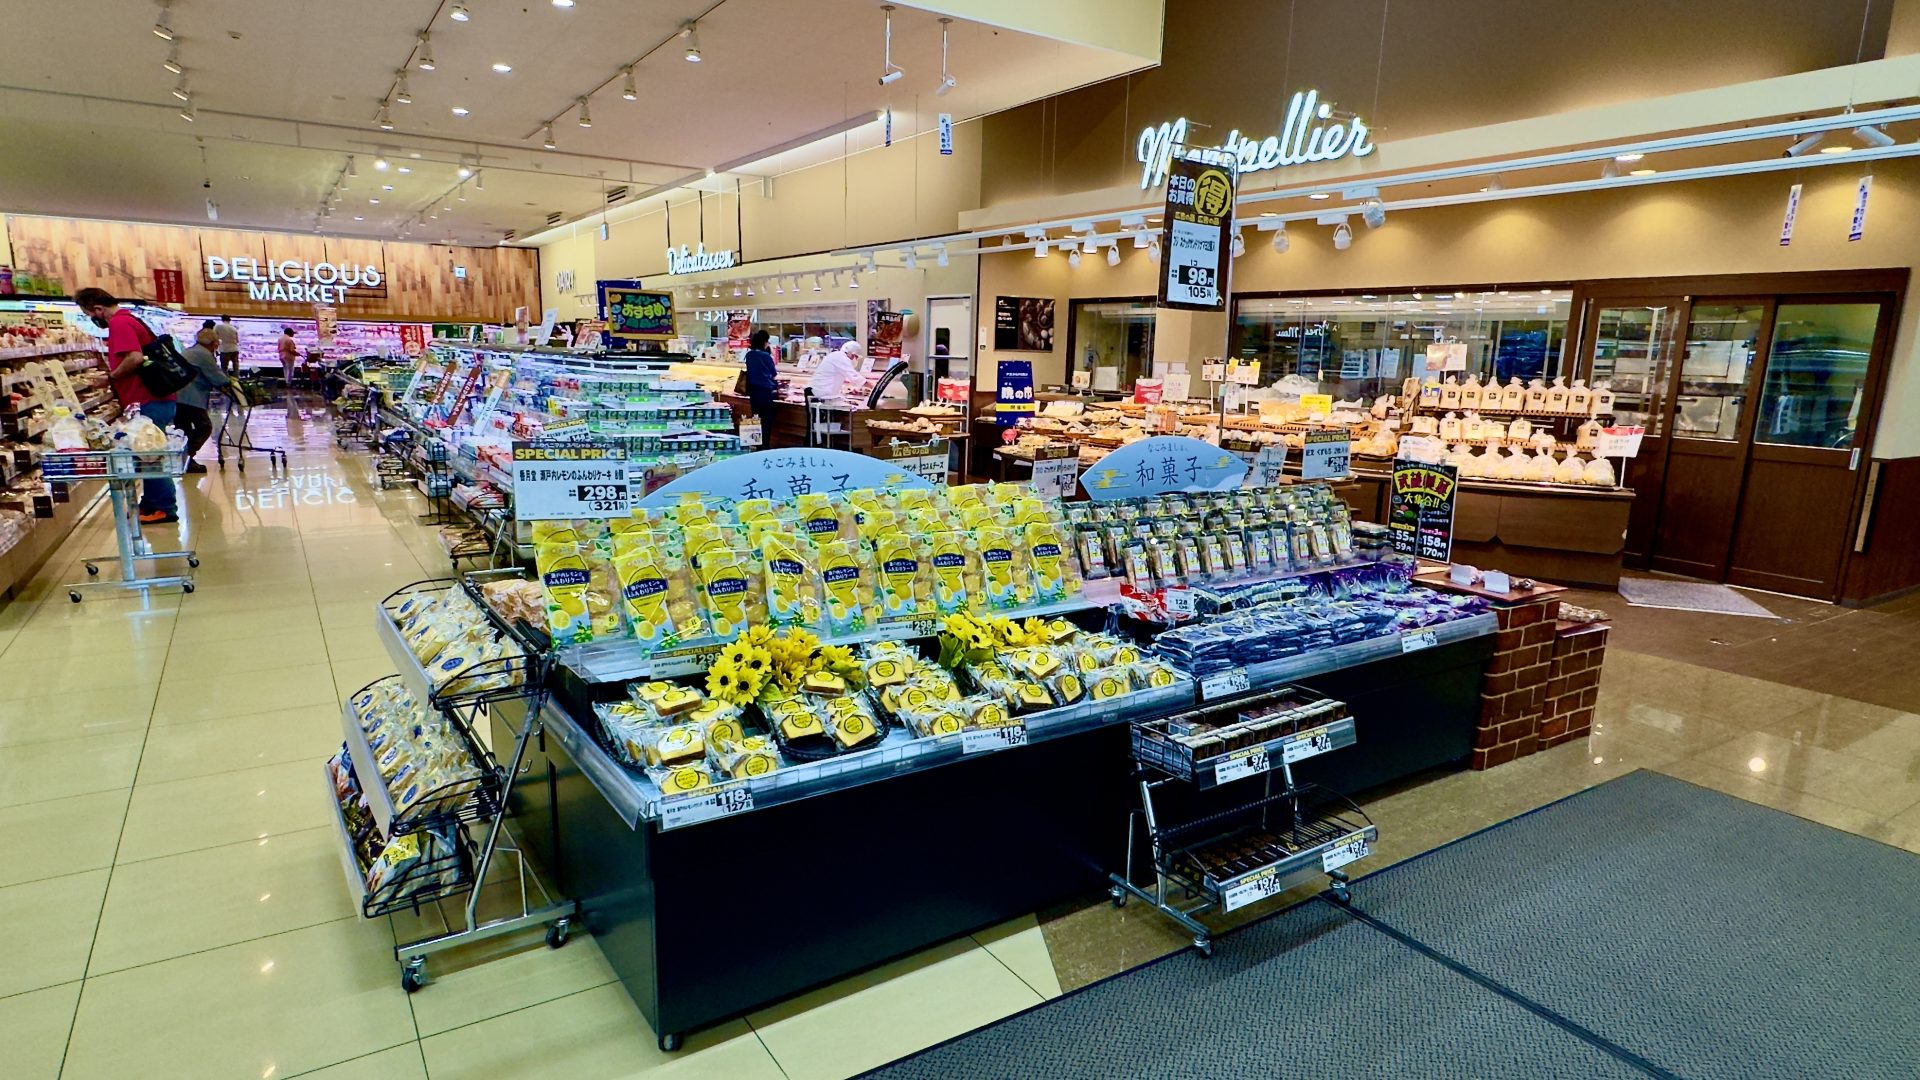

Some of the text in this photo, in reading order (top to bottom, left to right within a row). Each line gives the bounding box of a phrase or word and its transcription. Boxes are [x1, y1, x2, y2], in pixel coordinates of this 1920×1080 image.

[1169, 174, 1196, 191] 本日の
[667, 242, 736, 276] Delicatessen
[207, 255, 382, 287] DELICIOUS
[248, 281, 348, 304] MARKET
[622, 302, 666, 319] おすすめ
[515, 448, 625, 460] SPECIAL PRICE
[892, 446, 930, 457] 広告の品
[540, 470, 612, 480] 瀬戸内レモンのふんわりケーキ
[1136, 456, 1202, 487] 和菓子
[583, 486, 627, 500] 298円
